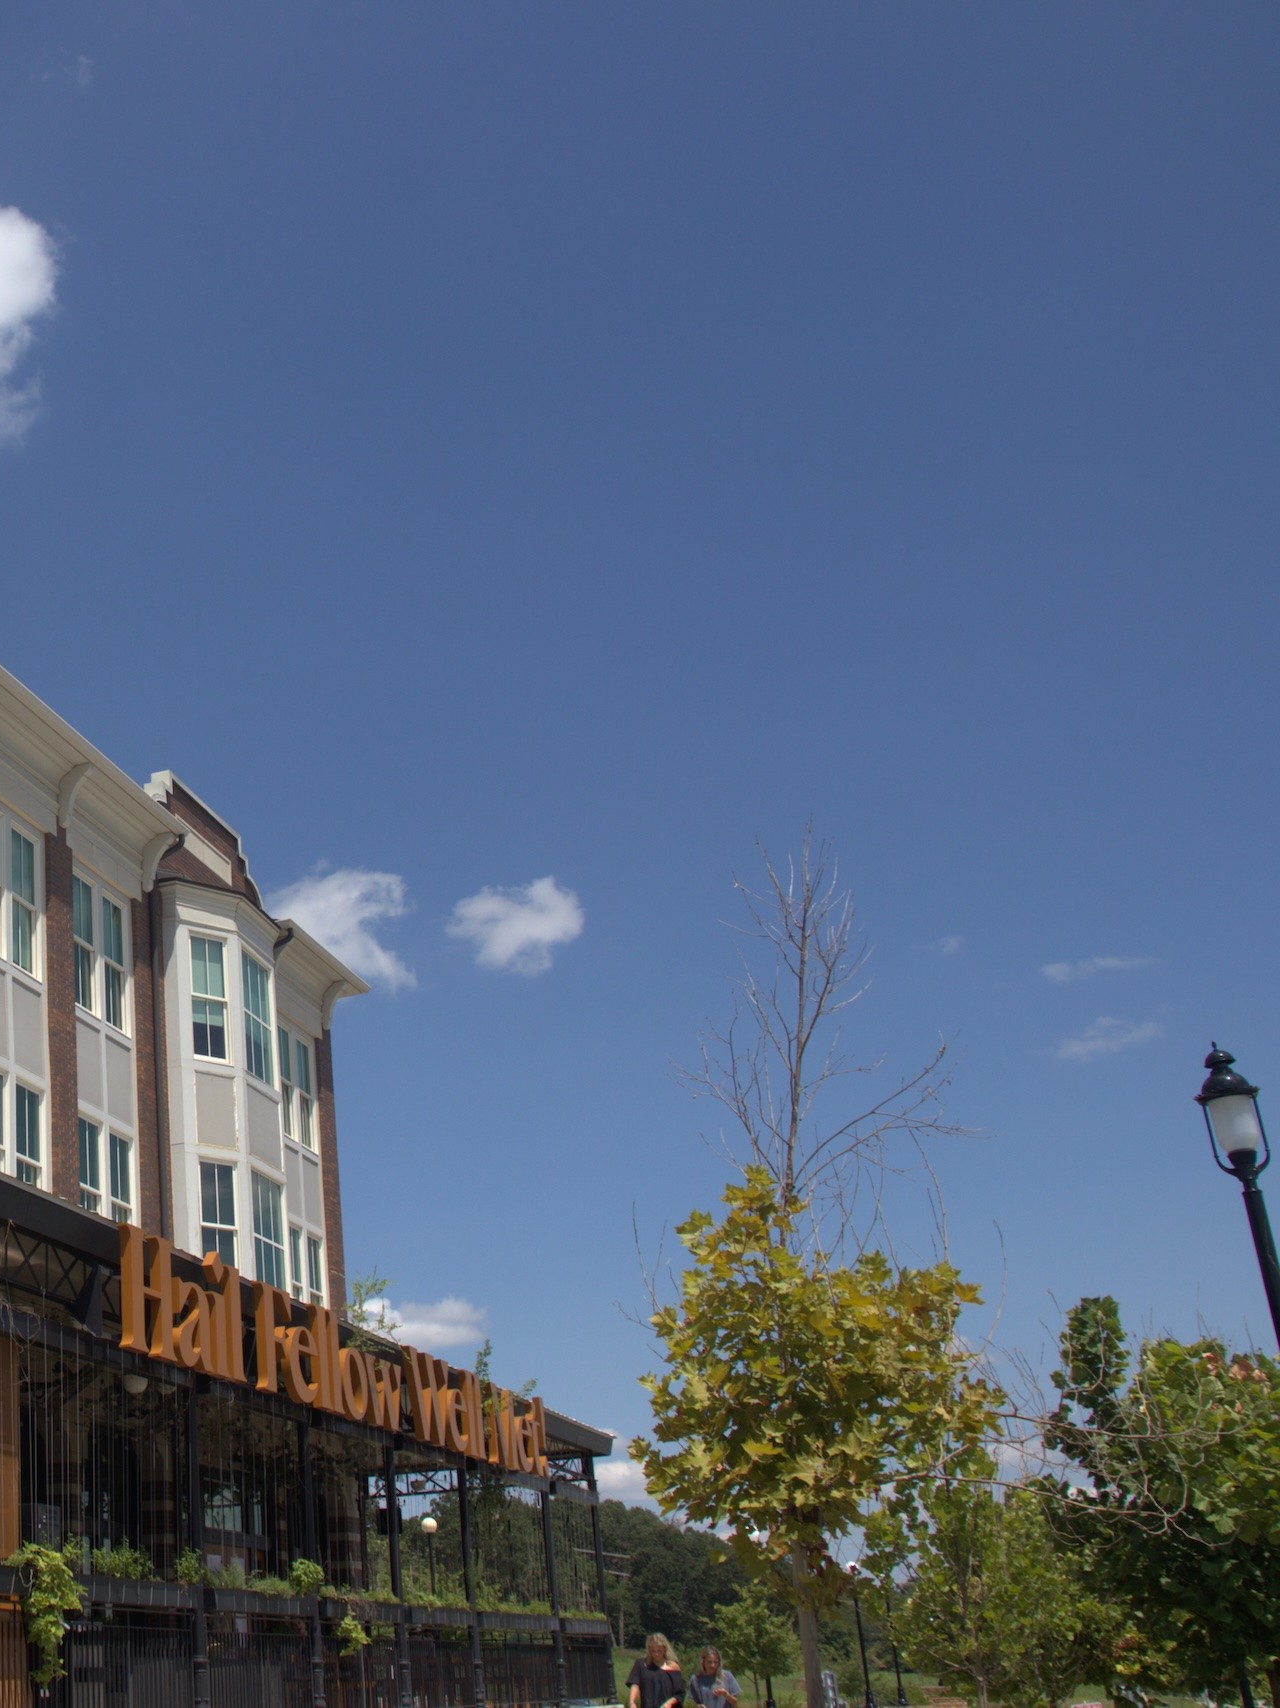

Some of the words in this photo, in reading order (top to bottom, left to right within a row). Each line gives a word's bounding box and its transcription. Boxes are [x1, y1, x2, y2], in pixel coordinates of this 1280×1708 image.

[120, 1224, 247, 1383] Hail
[254, 1281, 402, 1431] Fellow
[403, 1346, 486, 1459] Well
